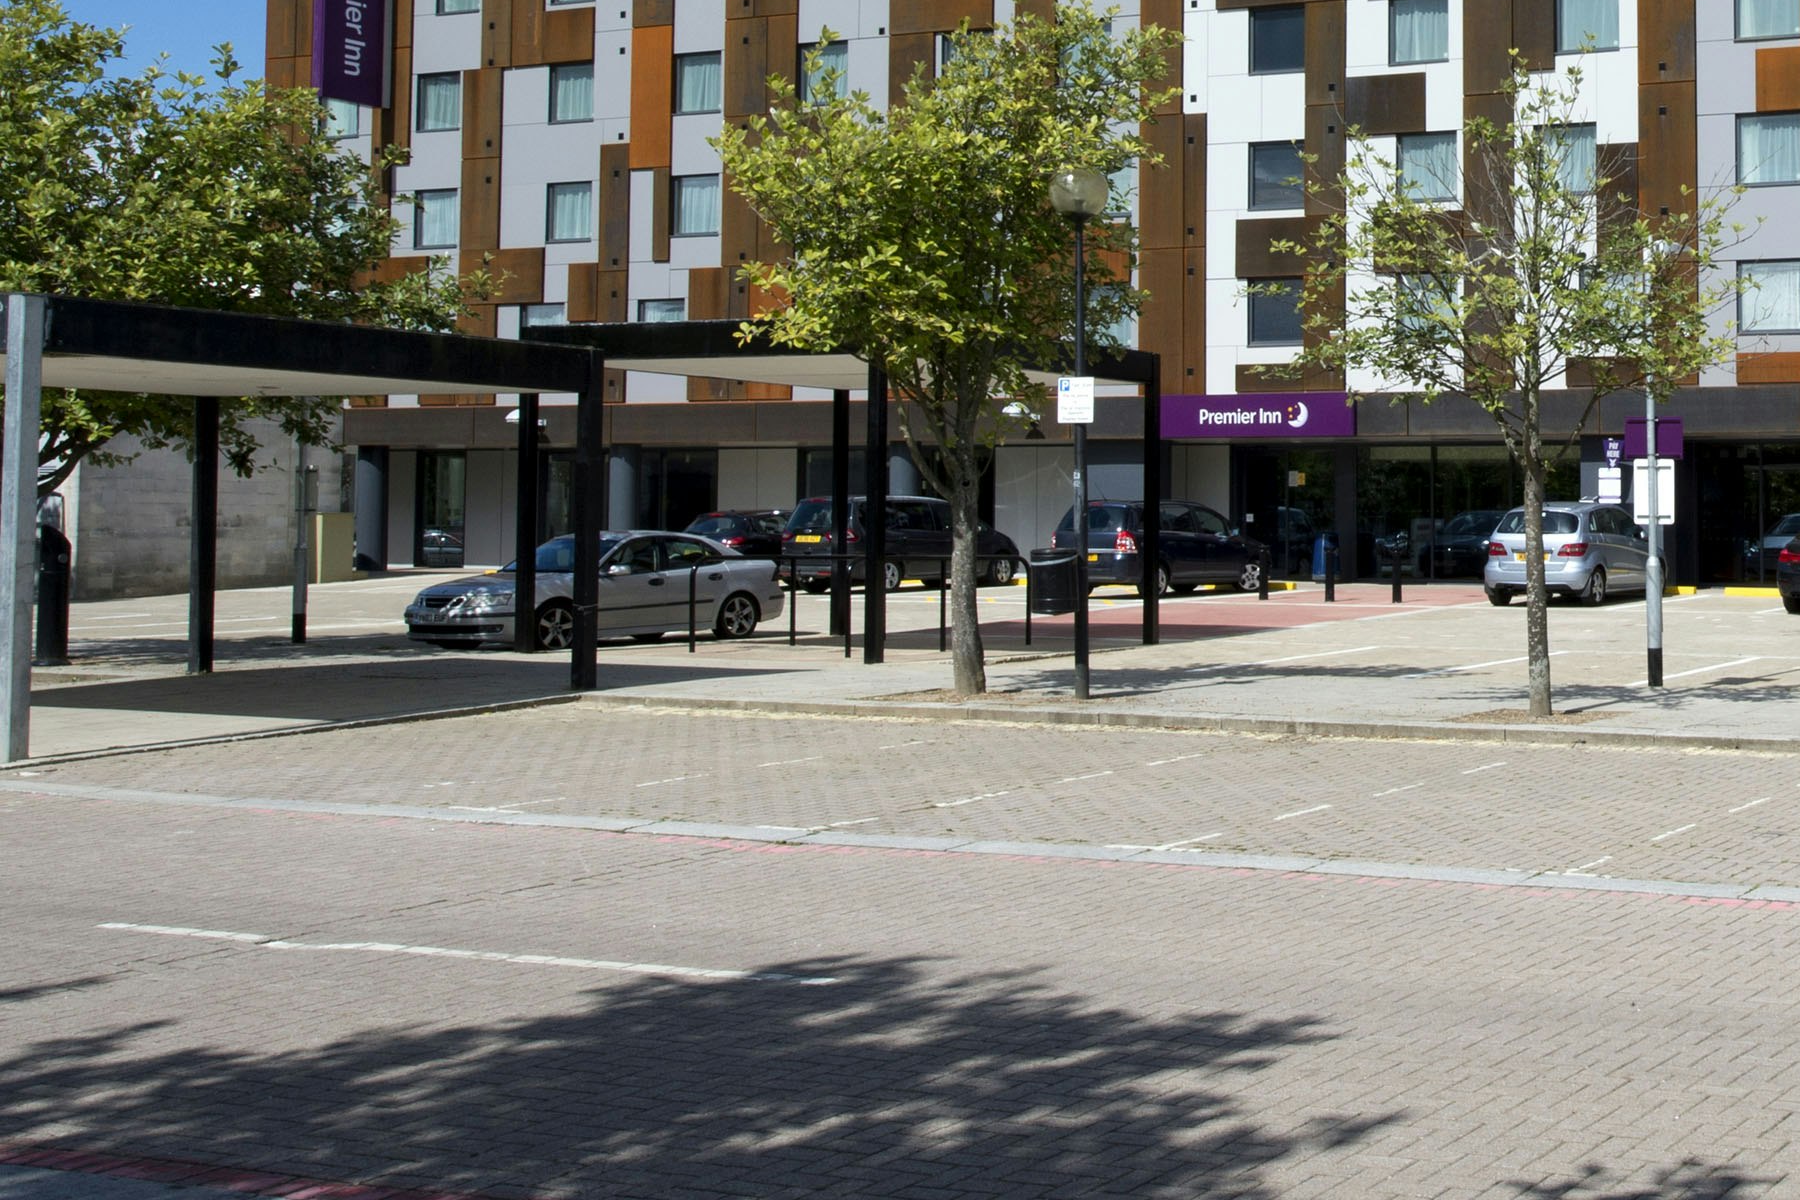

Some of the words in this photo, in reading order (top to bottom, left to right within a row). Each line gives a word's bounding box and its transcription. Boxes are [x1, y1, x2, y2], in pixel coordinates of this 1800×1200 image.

[343, 40, 368, 78] Inn
[1199, 408, 1257, 424] Premier
[1259, 407, 1282, 424] Inn
[1606, 450, 1620, 458] HERE
